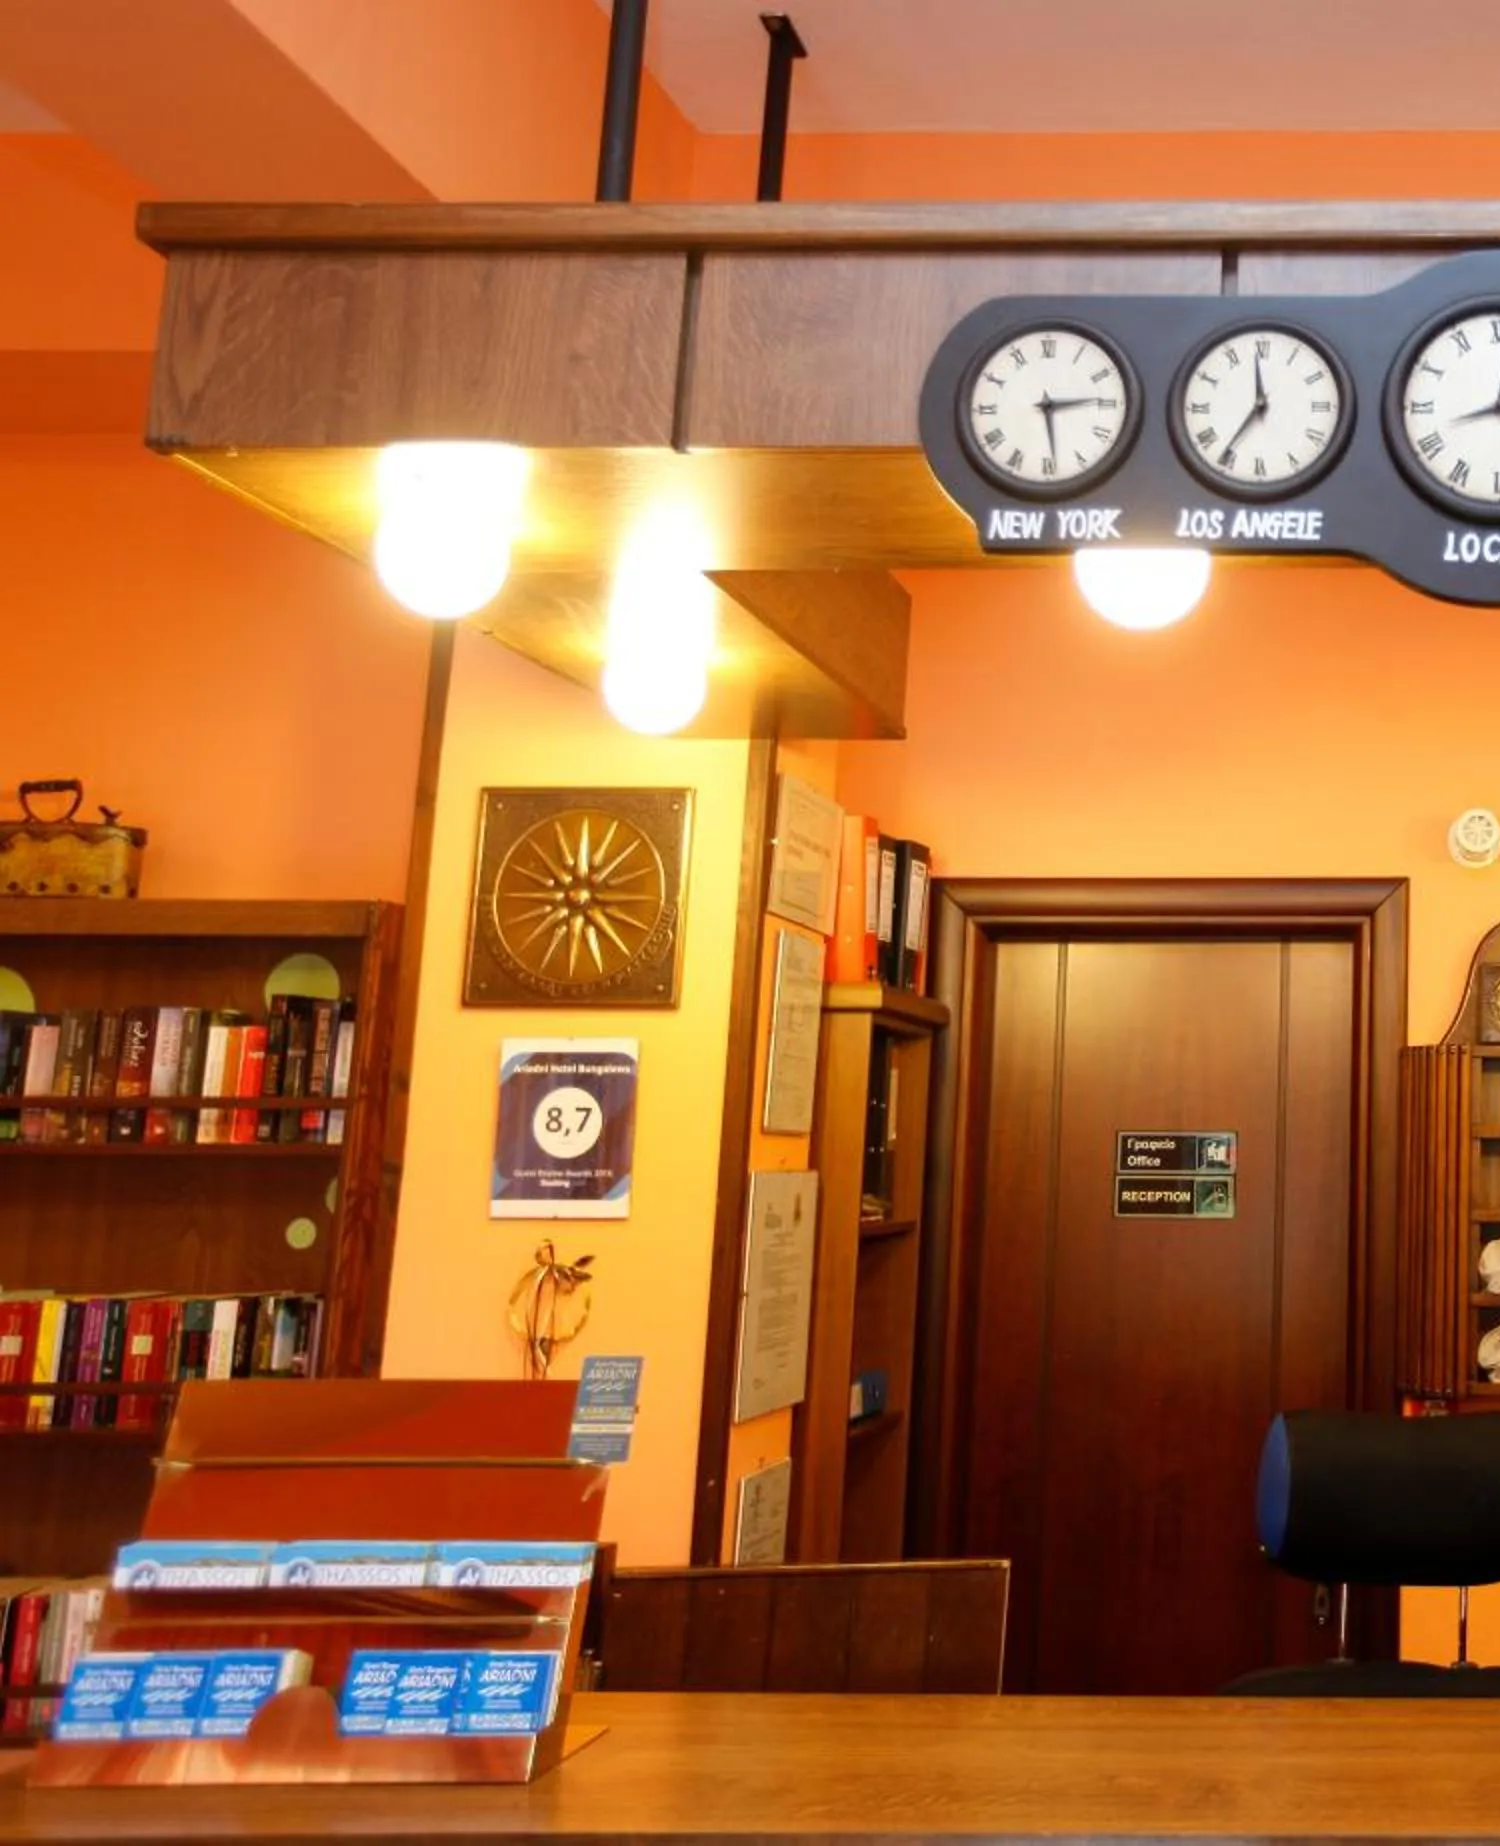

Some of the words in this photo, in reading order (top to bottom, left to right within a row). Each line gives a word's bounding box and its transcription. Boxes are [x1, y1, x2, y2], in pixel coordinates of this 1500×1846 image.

[988, 509, 1046, 540] NEW
[1057, 509, 1123, 540] YORK
[1176, 509, 1224, 539] LOS
[545, 1107, 592, 1137] 8,7
[1127, 1156, 1160, 1166] Office
[1122, 1191, 1191, 1202] RECEPTION
